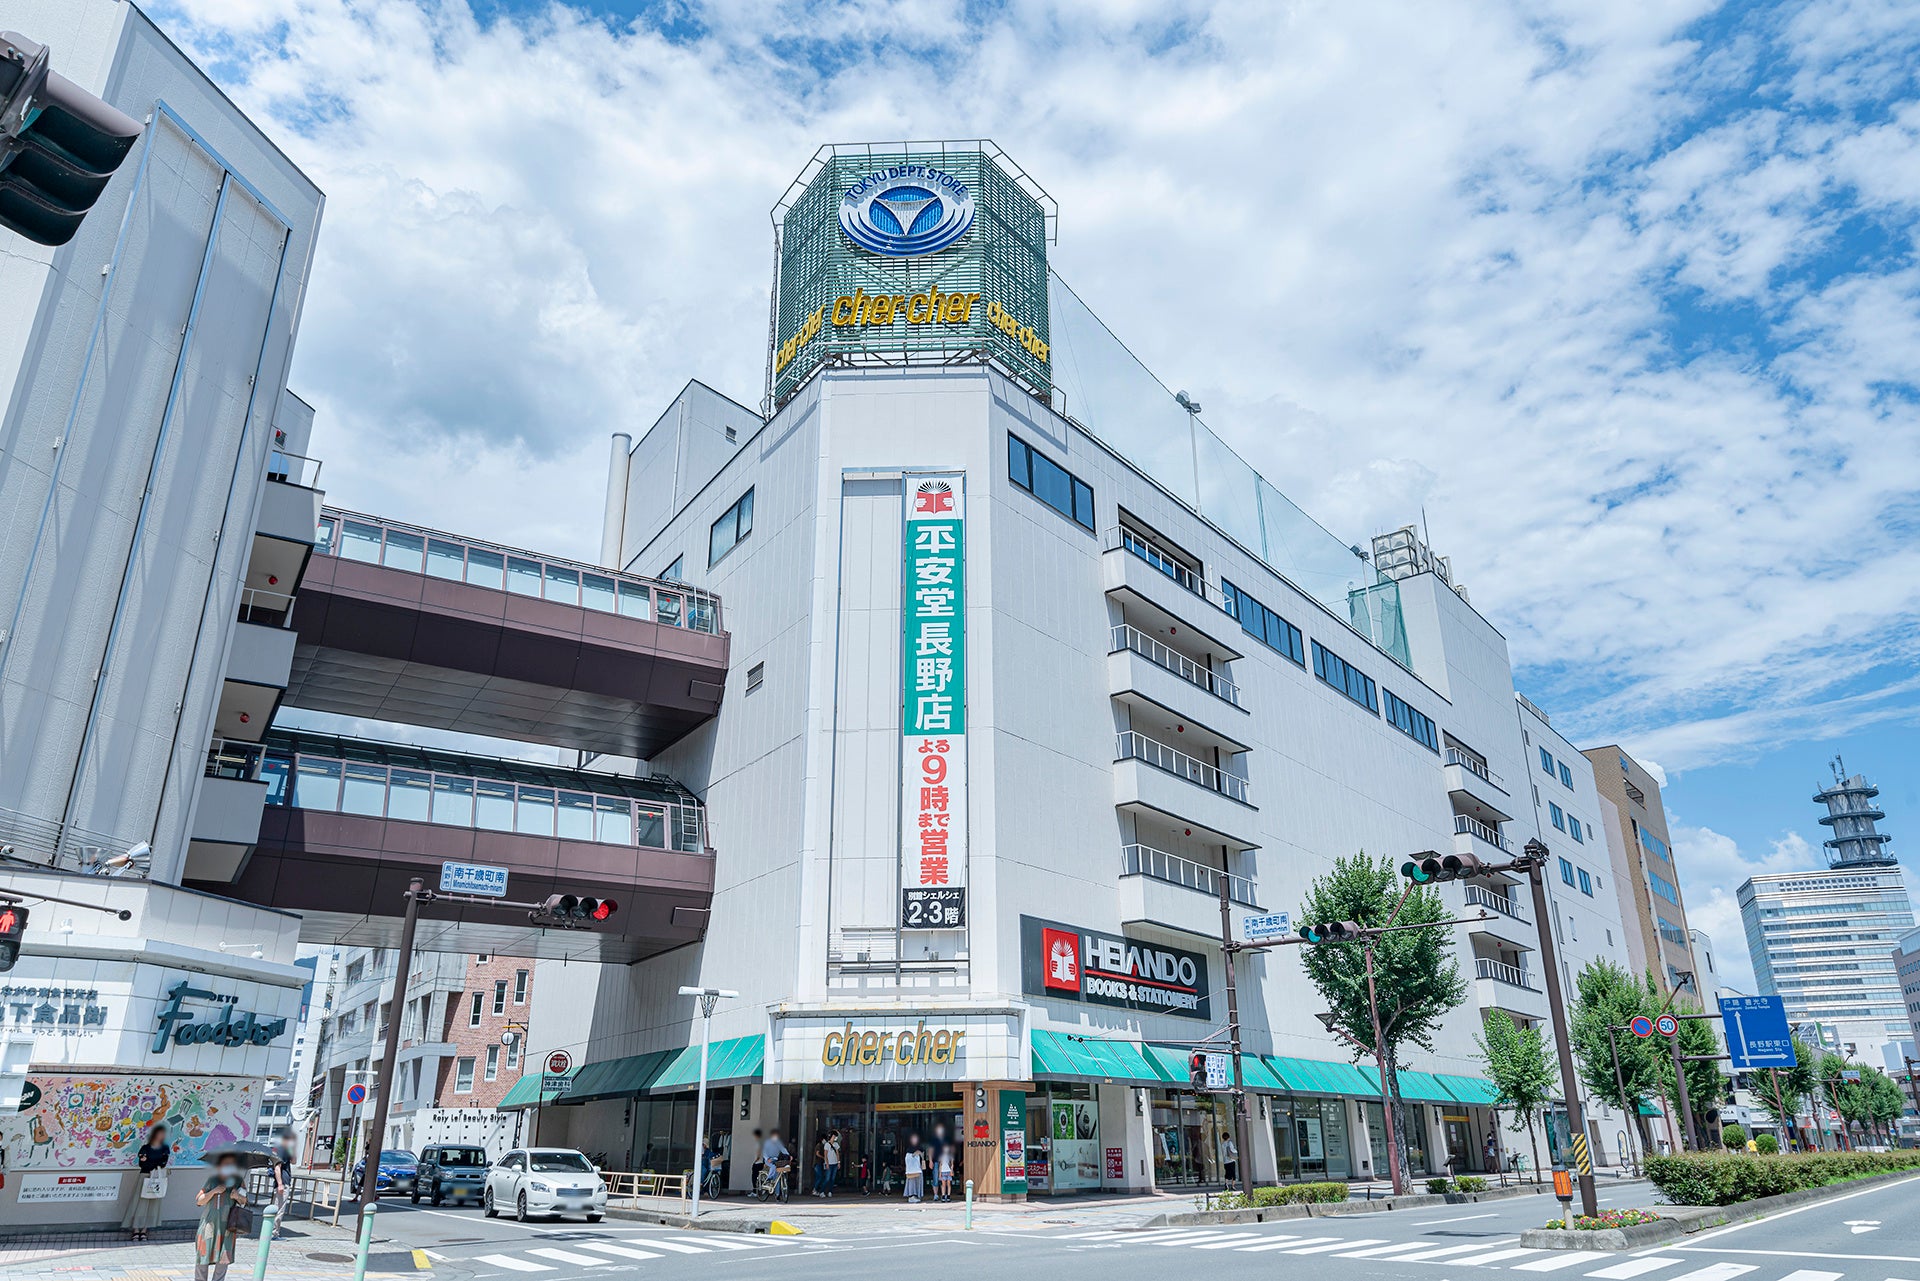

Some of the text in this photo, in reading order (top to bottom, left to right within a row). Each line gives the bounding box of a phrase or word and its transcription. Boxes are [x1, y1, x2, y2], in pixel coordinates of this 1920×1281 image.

[845, 165, 969, 200] TOKYU DEPT. STORE
[915, 525, 956, 731] 平安堂長野店
[454, 867, 505, 884] 南千歳町南
[1085, 935, 1197, 986] HEIANDO
[1086, 976, 1199, 1011] BOOKS & STATIONERY
[1745, 998, 1768, 1006] 善光寺
[1660, 1020, 1674, 1031] 50
[1750, 1039, 1790, 1048] 長野駅東口
[463, 1114, 487, 1123] Beauty
[490, 1114, 507, 1124] Style
[967, 1140, 997, 1148] HEIANDO
